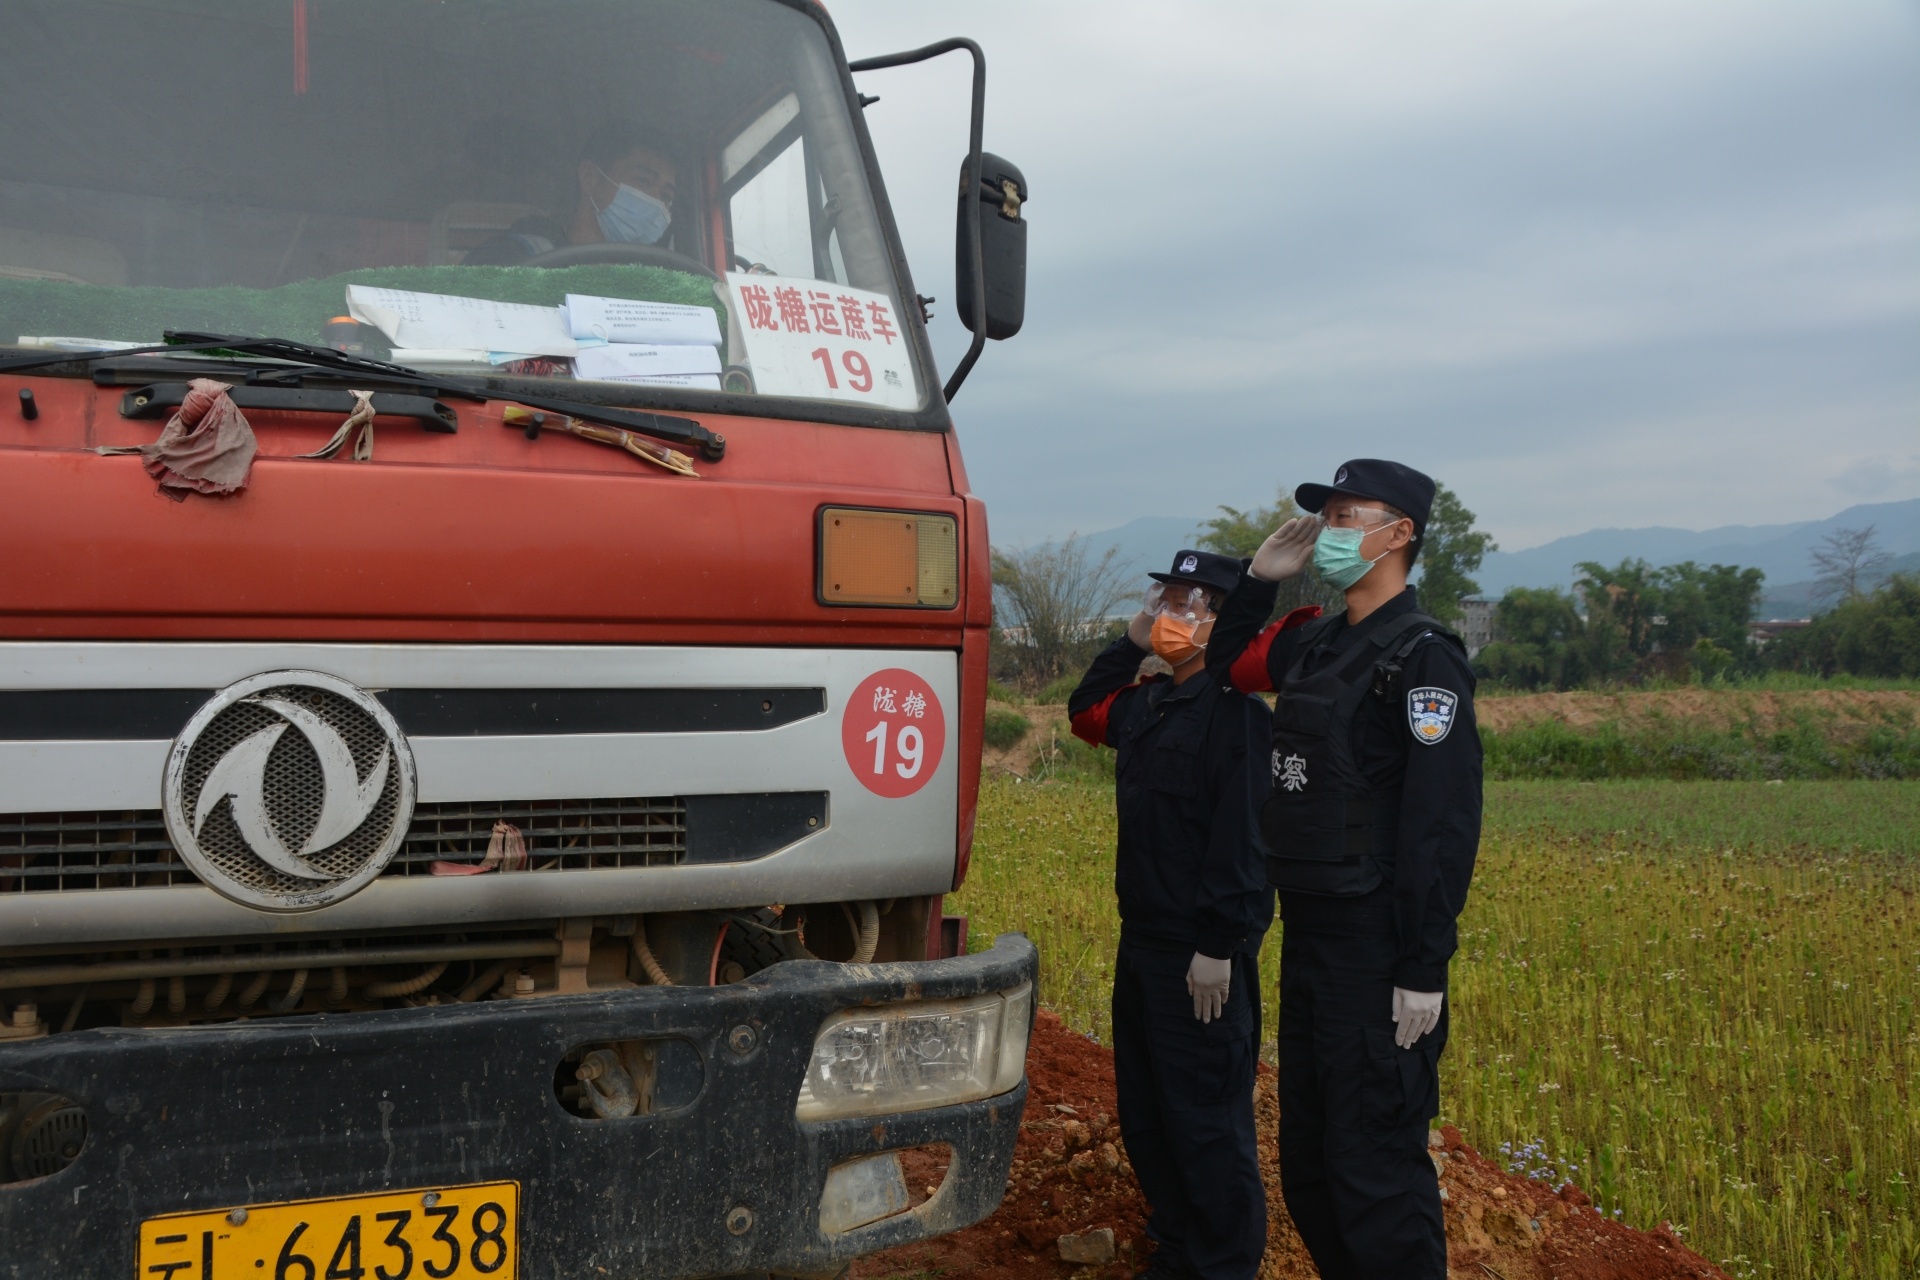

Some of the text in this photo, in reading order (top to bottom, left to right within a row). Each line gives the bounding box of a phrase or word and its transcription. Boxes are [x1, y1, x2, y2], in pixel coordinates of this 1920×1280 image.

[739, 284, 898, 346] 陇糖运蔗车
[811, 347, 874, 393] 19
[873, 686, 927, 719] 陇糖
[865, 720, 925, 779] 19
